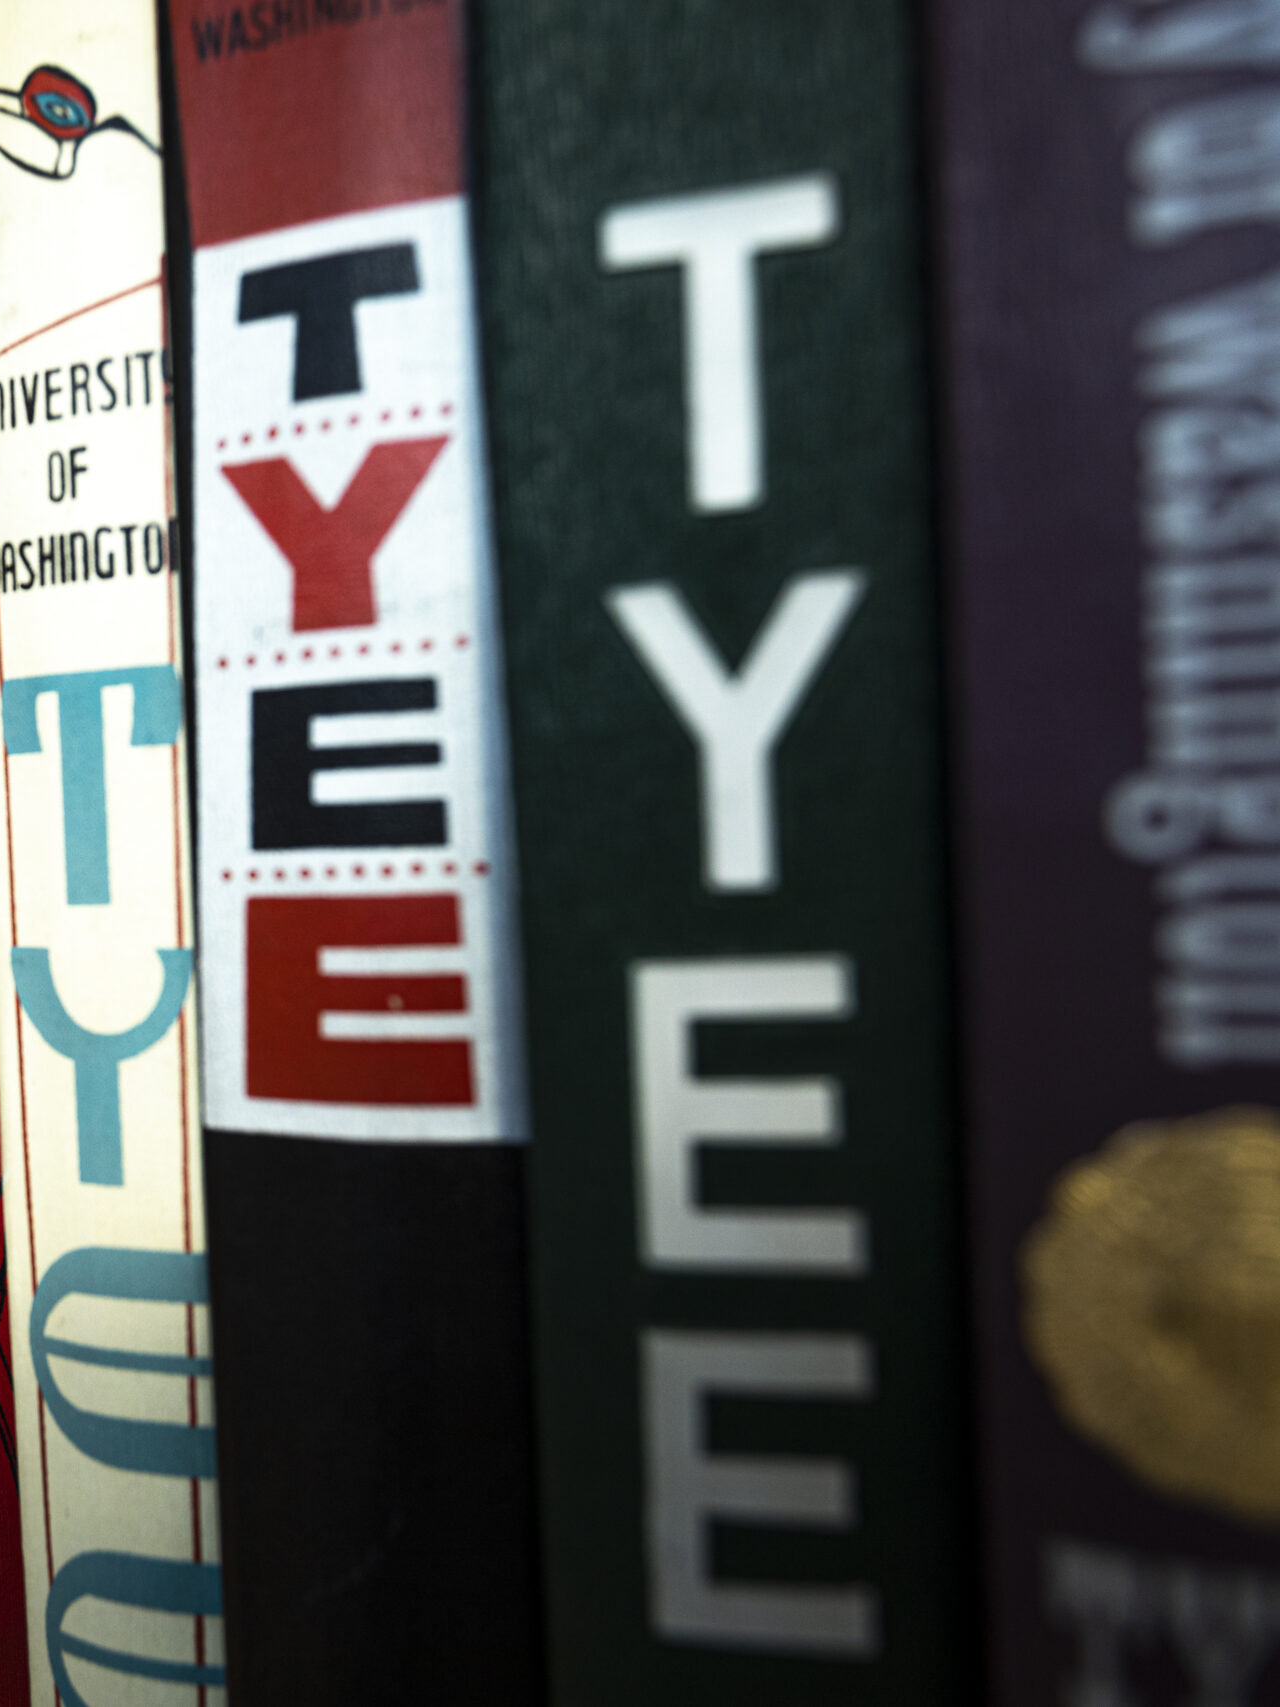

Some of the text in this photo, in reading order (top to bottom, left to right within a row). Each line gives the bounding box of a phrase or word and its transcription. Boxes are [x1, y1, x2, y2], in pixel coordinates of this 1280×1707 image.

[48, 446, 87, 502] OF
[220, 240, 477, 1109] TYEE
[600, 174, 878, 1656] TYEE
